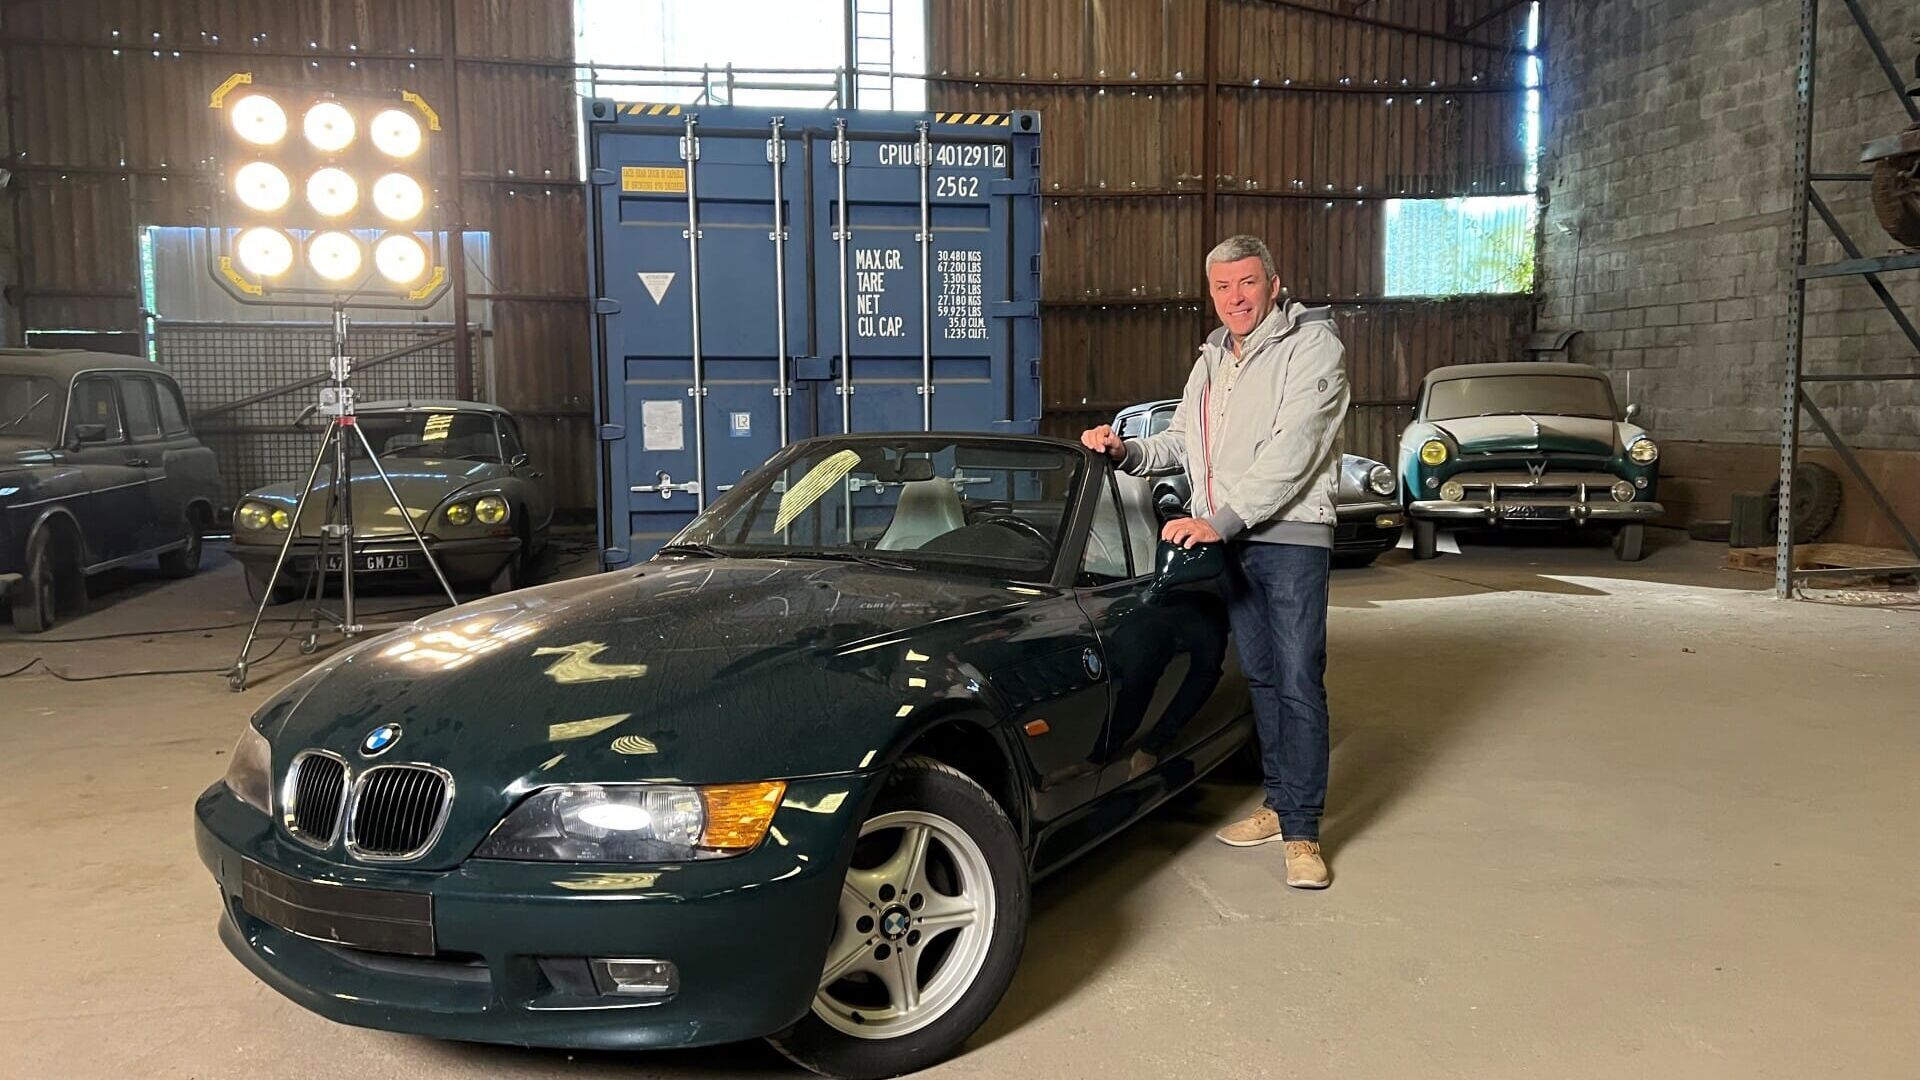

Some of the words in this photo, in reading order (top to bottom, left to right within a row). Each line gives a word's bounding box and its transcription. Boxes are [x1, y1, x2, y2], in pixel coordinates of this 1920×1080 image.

[879, 144, 912, 165] CPIU
[936, 145, 989, 167] 401291
[994, 146, 1004, 166] 2
[936, 176, 979, 197] 25G2
[938, 250, 966, 261] 30.480
[968, 250, 982, 261] KGS
[938, 262, 966, 272] 67.200
[968, 262, 982, 272] LBS
[856, 272, 885, 292] TARE
[944, 274, 966, 284] 3.300
[968, 274, 982, 284] KGS
[944, 284, 966, 294] 7.275
[968, 284, 982, 294] LBS
[857, 294, 880, 315] NET
[938, 295, 966, 306] 27.180
[968, 295, 982, 306] KGS
[938, 306, 966, 316] 59.925
[968, 306, 982, 316] LBS
[858, 316, 876, 336] CU.
[878, 316, 905, 336] CAP.
[948, 318, 966, 328] 35.0
[944, 328, 966, 338] 1.235
